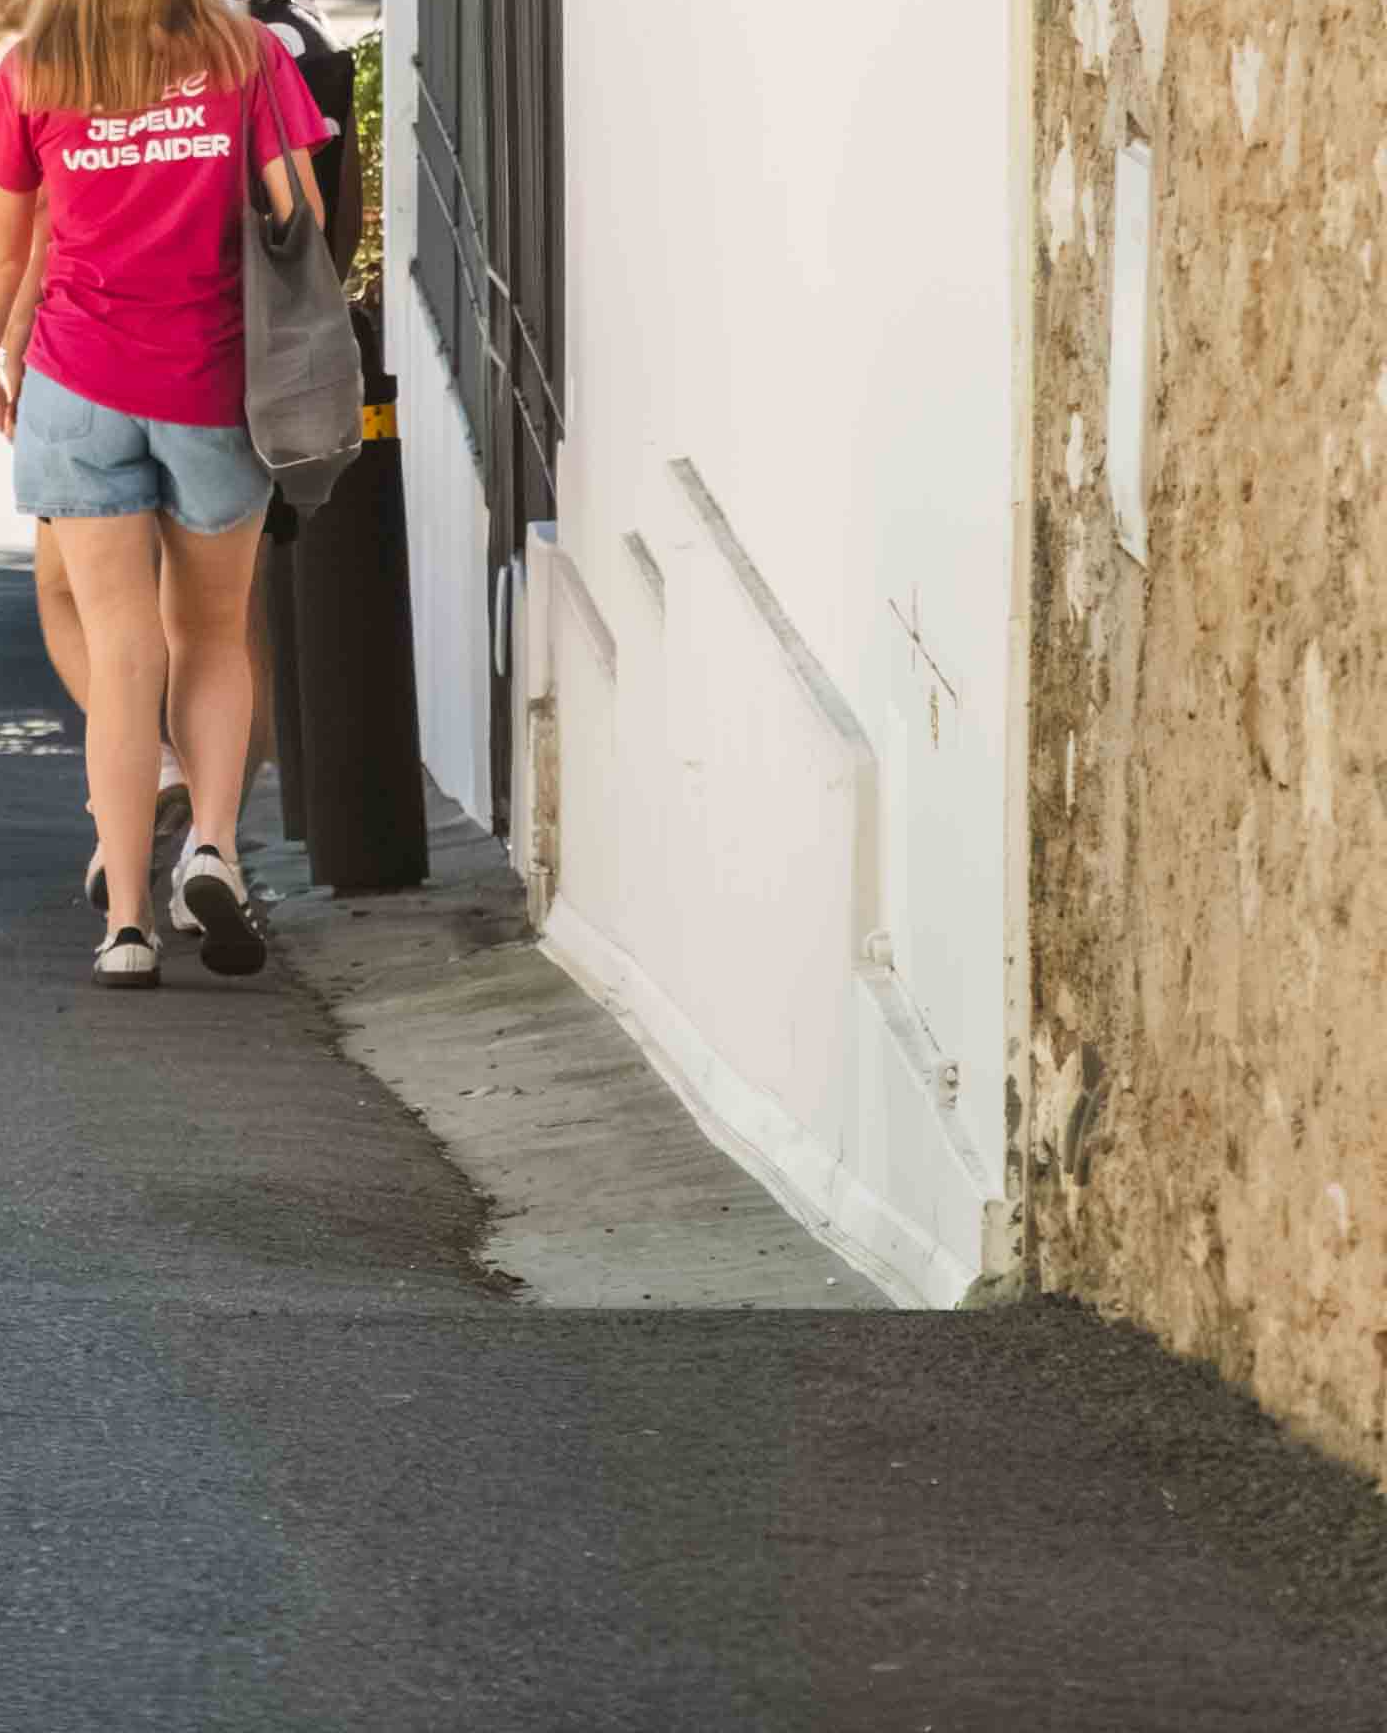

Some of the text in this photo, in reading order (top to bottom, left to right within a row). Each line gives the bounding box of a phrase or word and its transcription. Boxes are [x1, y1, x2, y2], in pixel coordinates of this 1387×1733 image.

[87, 106, 206, 142] JE PEUX
[62, 134, 231, 172] VOUS AIDER
